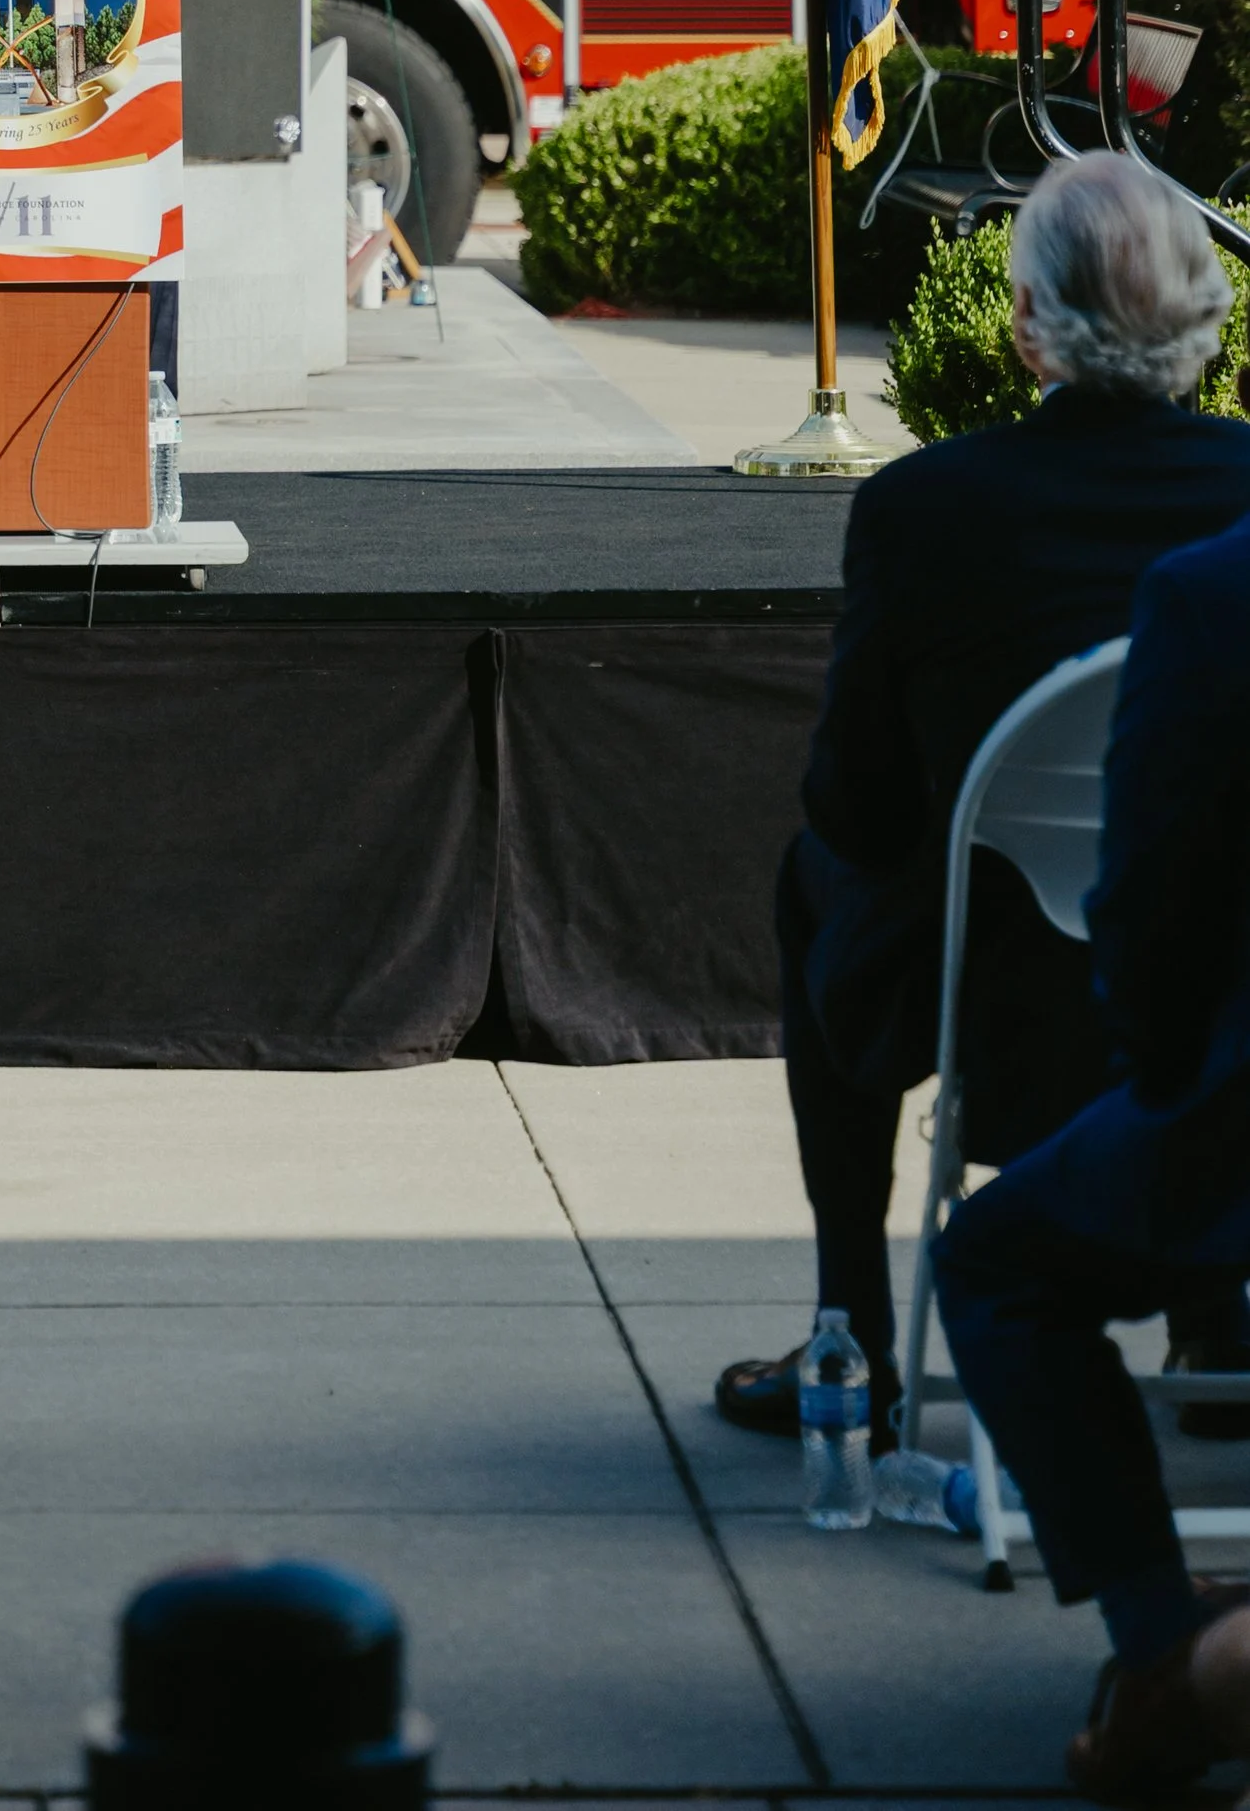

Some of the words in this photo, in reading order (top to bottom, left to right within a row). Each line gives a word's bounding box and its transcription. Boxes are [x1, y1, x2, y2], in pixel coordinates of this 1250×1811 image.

[28, 124, 42, 137] 25
[45, 114, 80, 131] Years
[18, 200, 85, 209] FOUNDATION
[15, 214, 82, 222] CAROLINA
